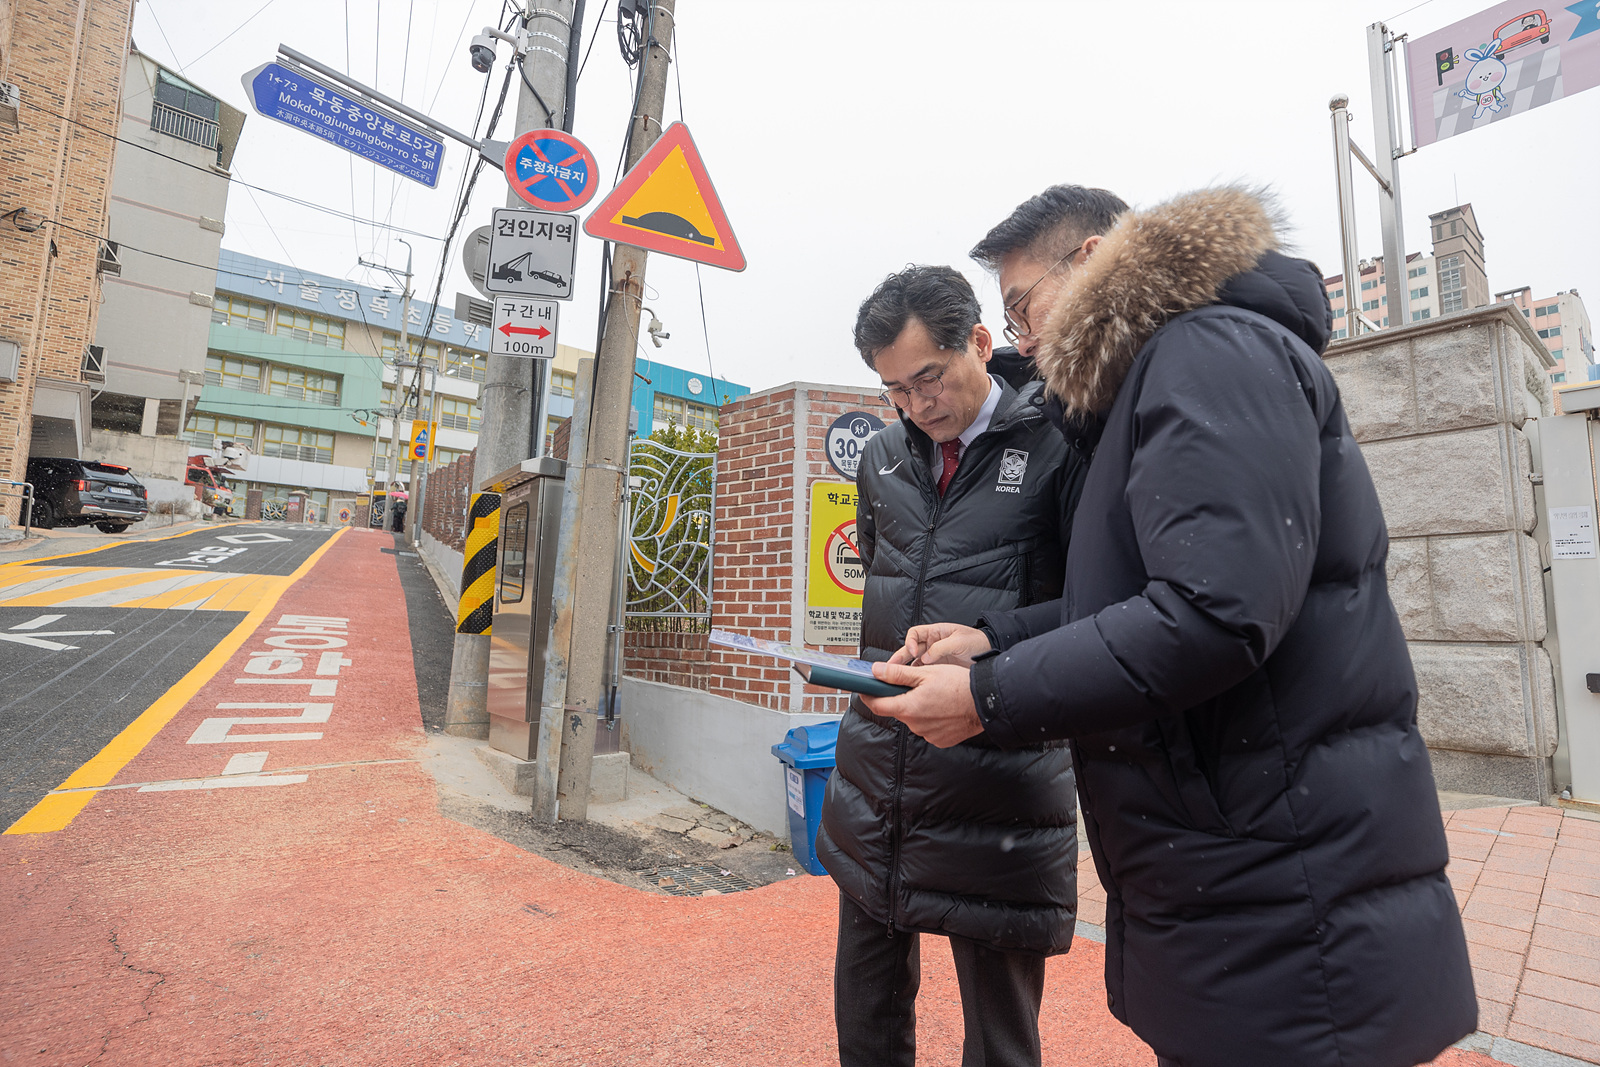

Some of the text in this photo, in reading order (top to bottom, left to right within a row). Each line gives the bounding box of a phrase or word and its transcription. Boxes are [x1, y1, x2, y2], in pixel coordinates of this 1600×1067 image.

[279, 91, 435, 171] Mokdongjungangbon-ro 5-gil
[309, 86, 438, 159] 목동중앙본로5길
[519, 157, 585, 184] 주정차금지
[497, 218, 572, 243] 견인지역
[503, 341, 544, 354] 100m
[995, 485, 1020, 493] KOREA
